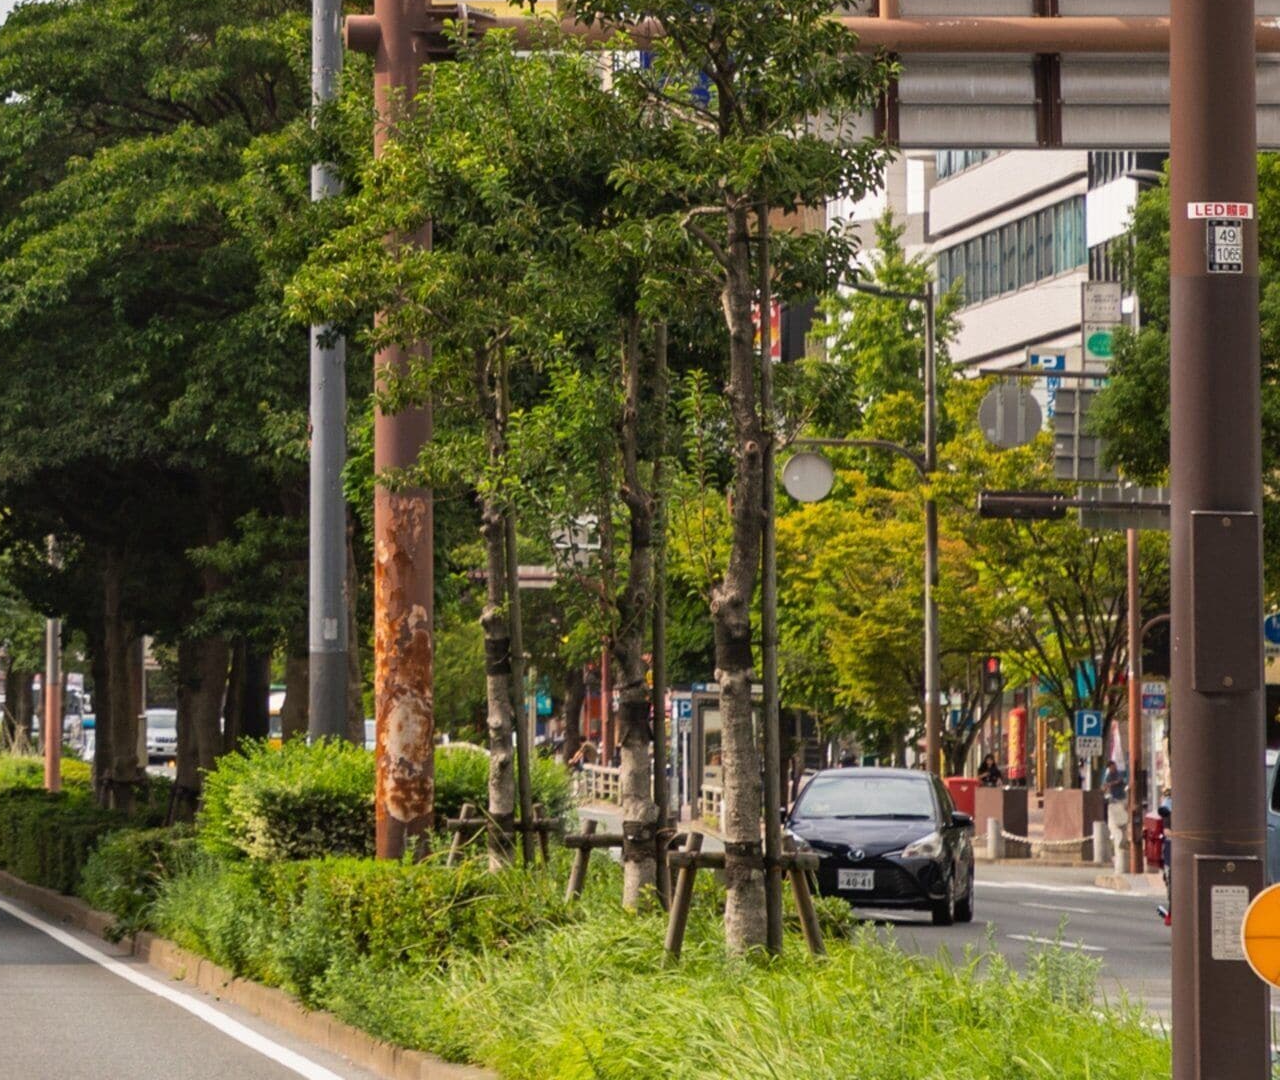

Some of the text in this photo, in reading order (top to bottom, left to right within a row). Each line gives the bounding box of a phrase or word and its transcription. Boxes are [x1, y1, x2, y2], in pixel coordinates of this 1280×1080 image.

[1219, 229, 1236, 243] 49
[1217, 247, 1241, 261] 1065
[681, 701, 692, 717] P
[1083, 714, 1097, 735] P
